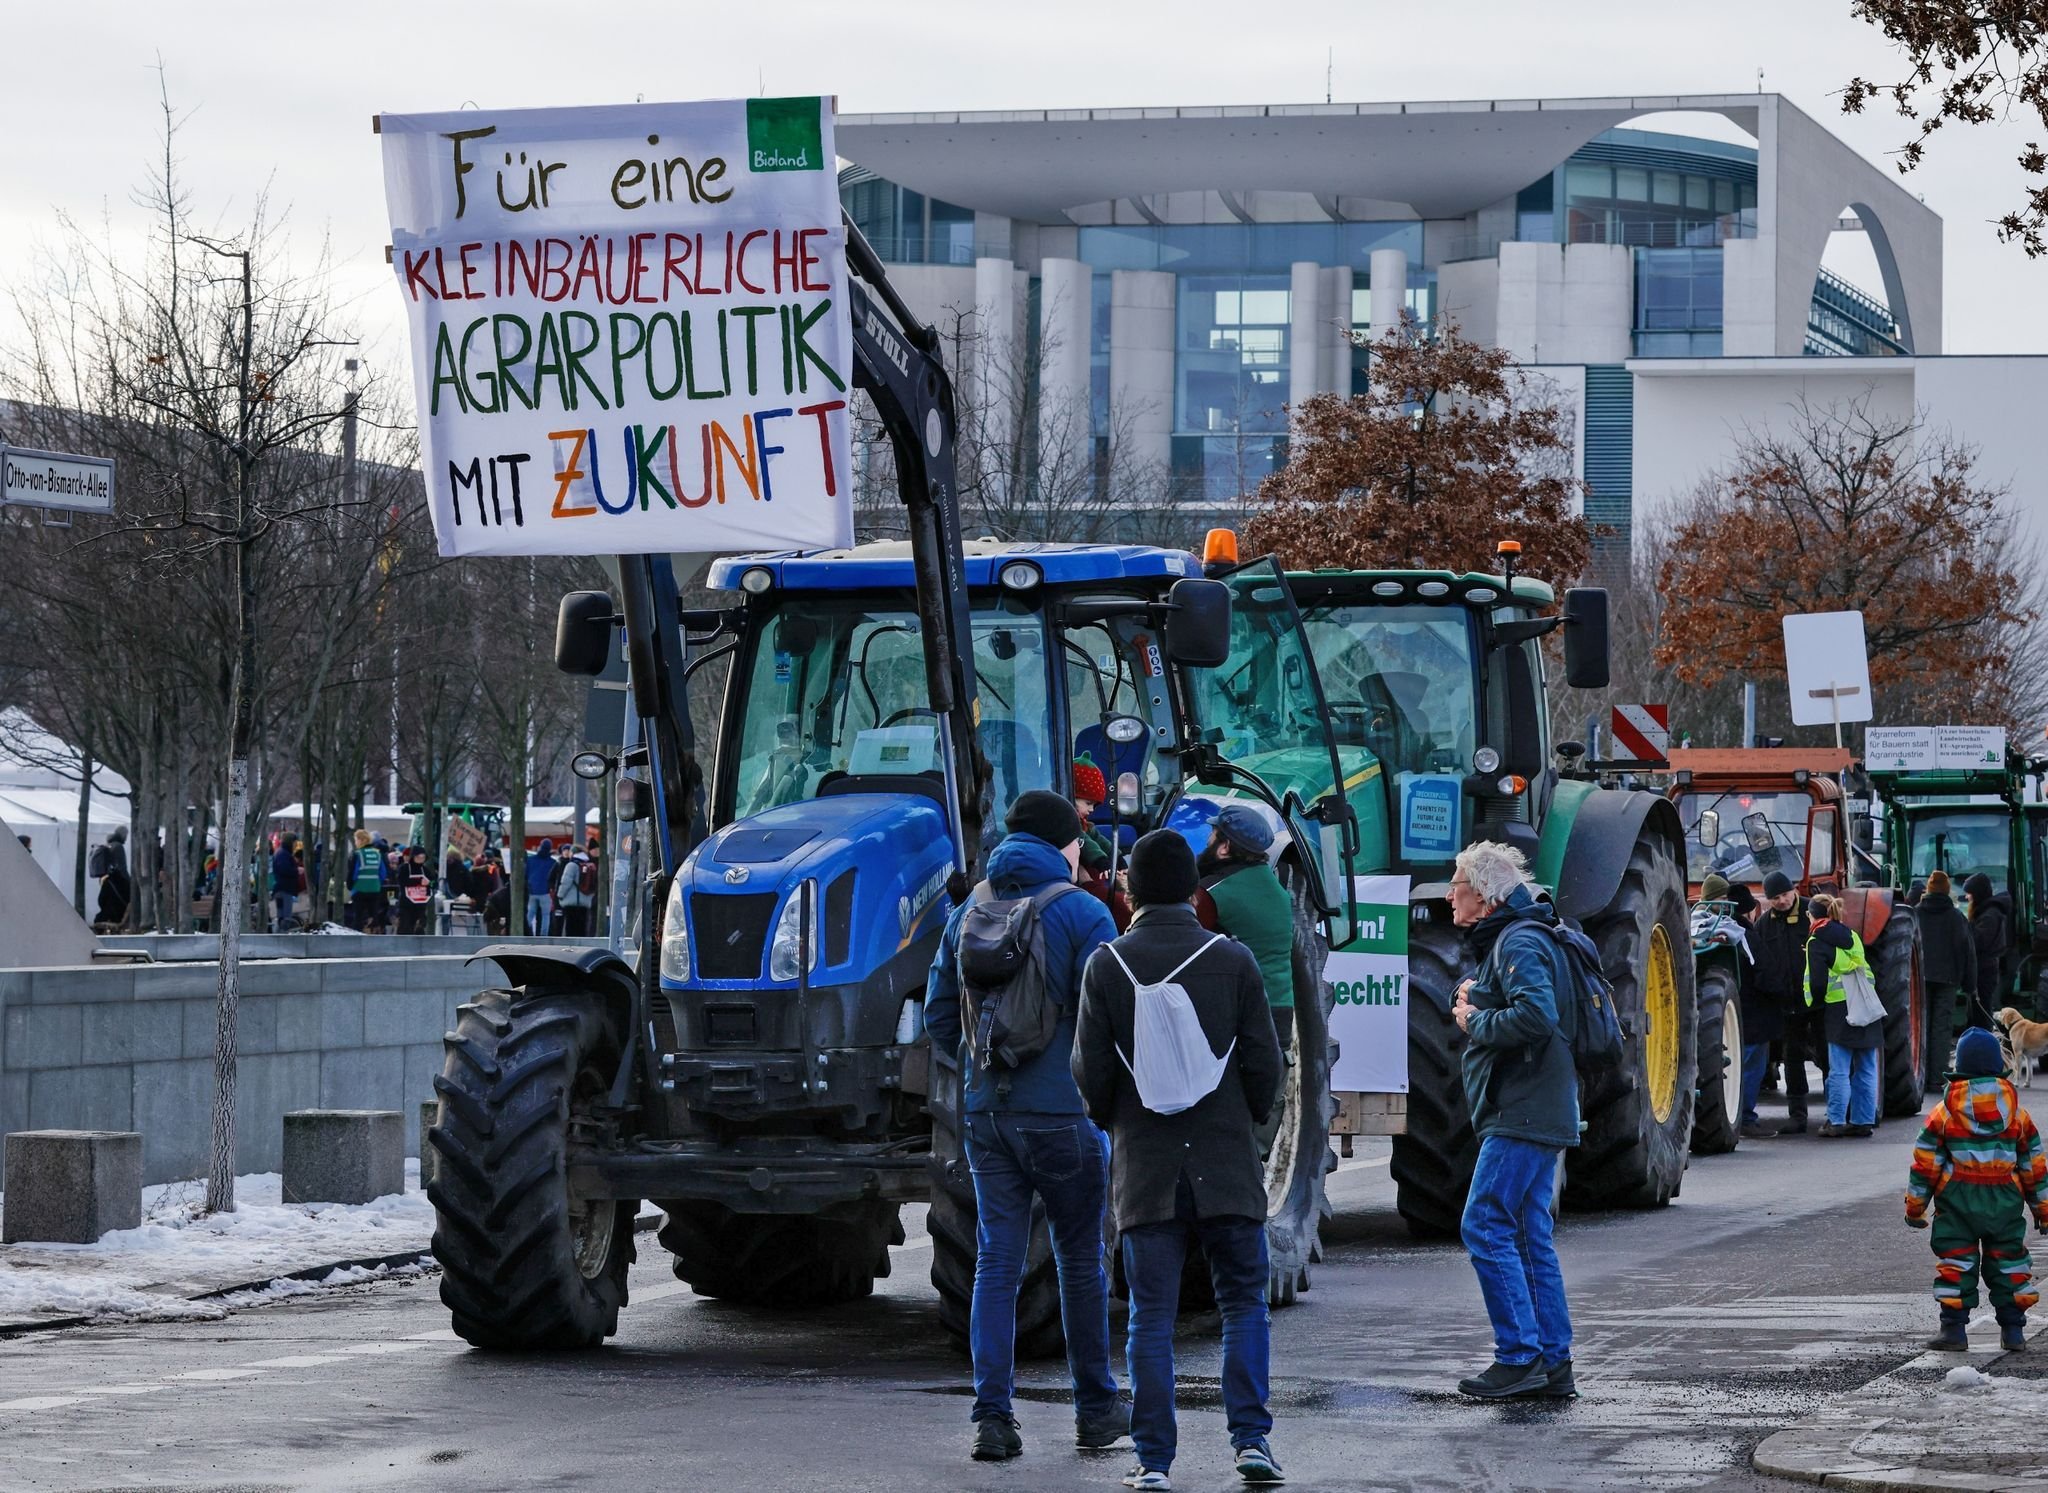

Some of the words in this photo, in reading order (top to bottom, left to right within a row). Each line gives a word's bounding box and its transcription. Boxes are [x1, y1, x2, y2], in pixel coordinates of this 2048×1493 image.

[440, 125, 567, 219] Für
[611, 134, 735, 209] eine
[754, 147, 808, 168] Bioland
[404, 228, 831, 305] KLEINBÄUERLICHE
[431, 298, 846, 416] AGRARPOLITIK
[865, 310, 909, 378] STOLL
[6, 461, 107, 499] Otto-von-Bismarck-Allee
[448, 453, 530, 527] MIT
[548, 400, 846, 519] ZUKUNFT
[1869, 730, 1916, 740] Agrarreform
[1869, 740, 1881, 748] für
[1912, 740, 1929, 748] statt
[1869, 750, 1924, 760] Agrarindustrie
[912, 881, 928, 917] NEW
